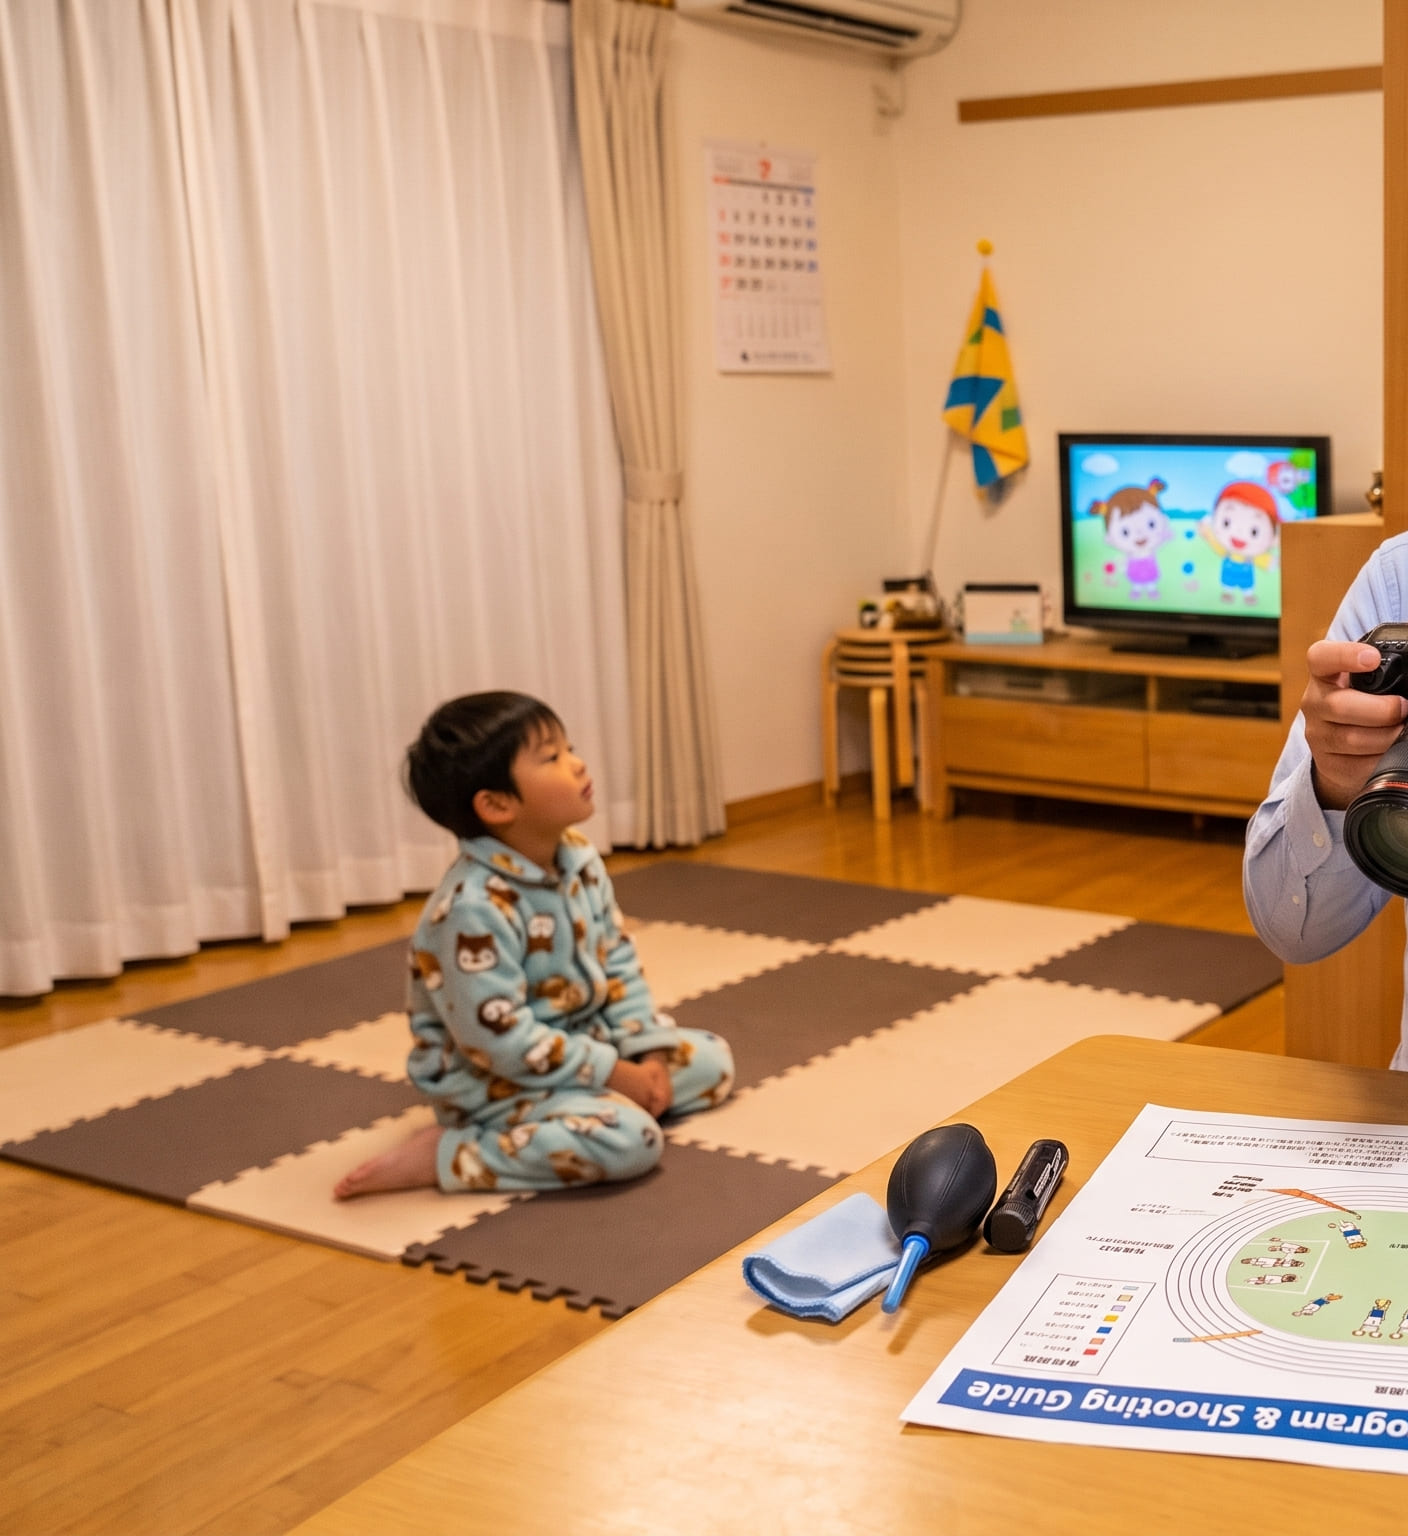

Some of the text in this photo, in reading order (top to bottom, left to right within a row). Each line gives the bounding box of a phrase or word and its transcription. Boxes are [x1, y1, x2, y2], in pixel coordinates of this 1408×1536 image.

[967, 1380, 1073, 1412] Guide
[1079, 1388, 1246, 1428] Shooting
[1253, 1406, 1282, 1430] &
